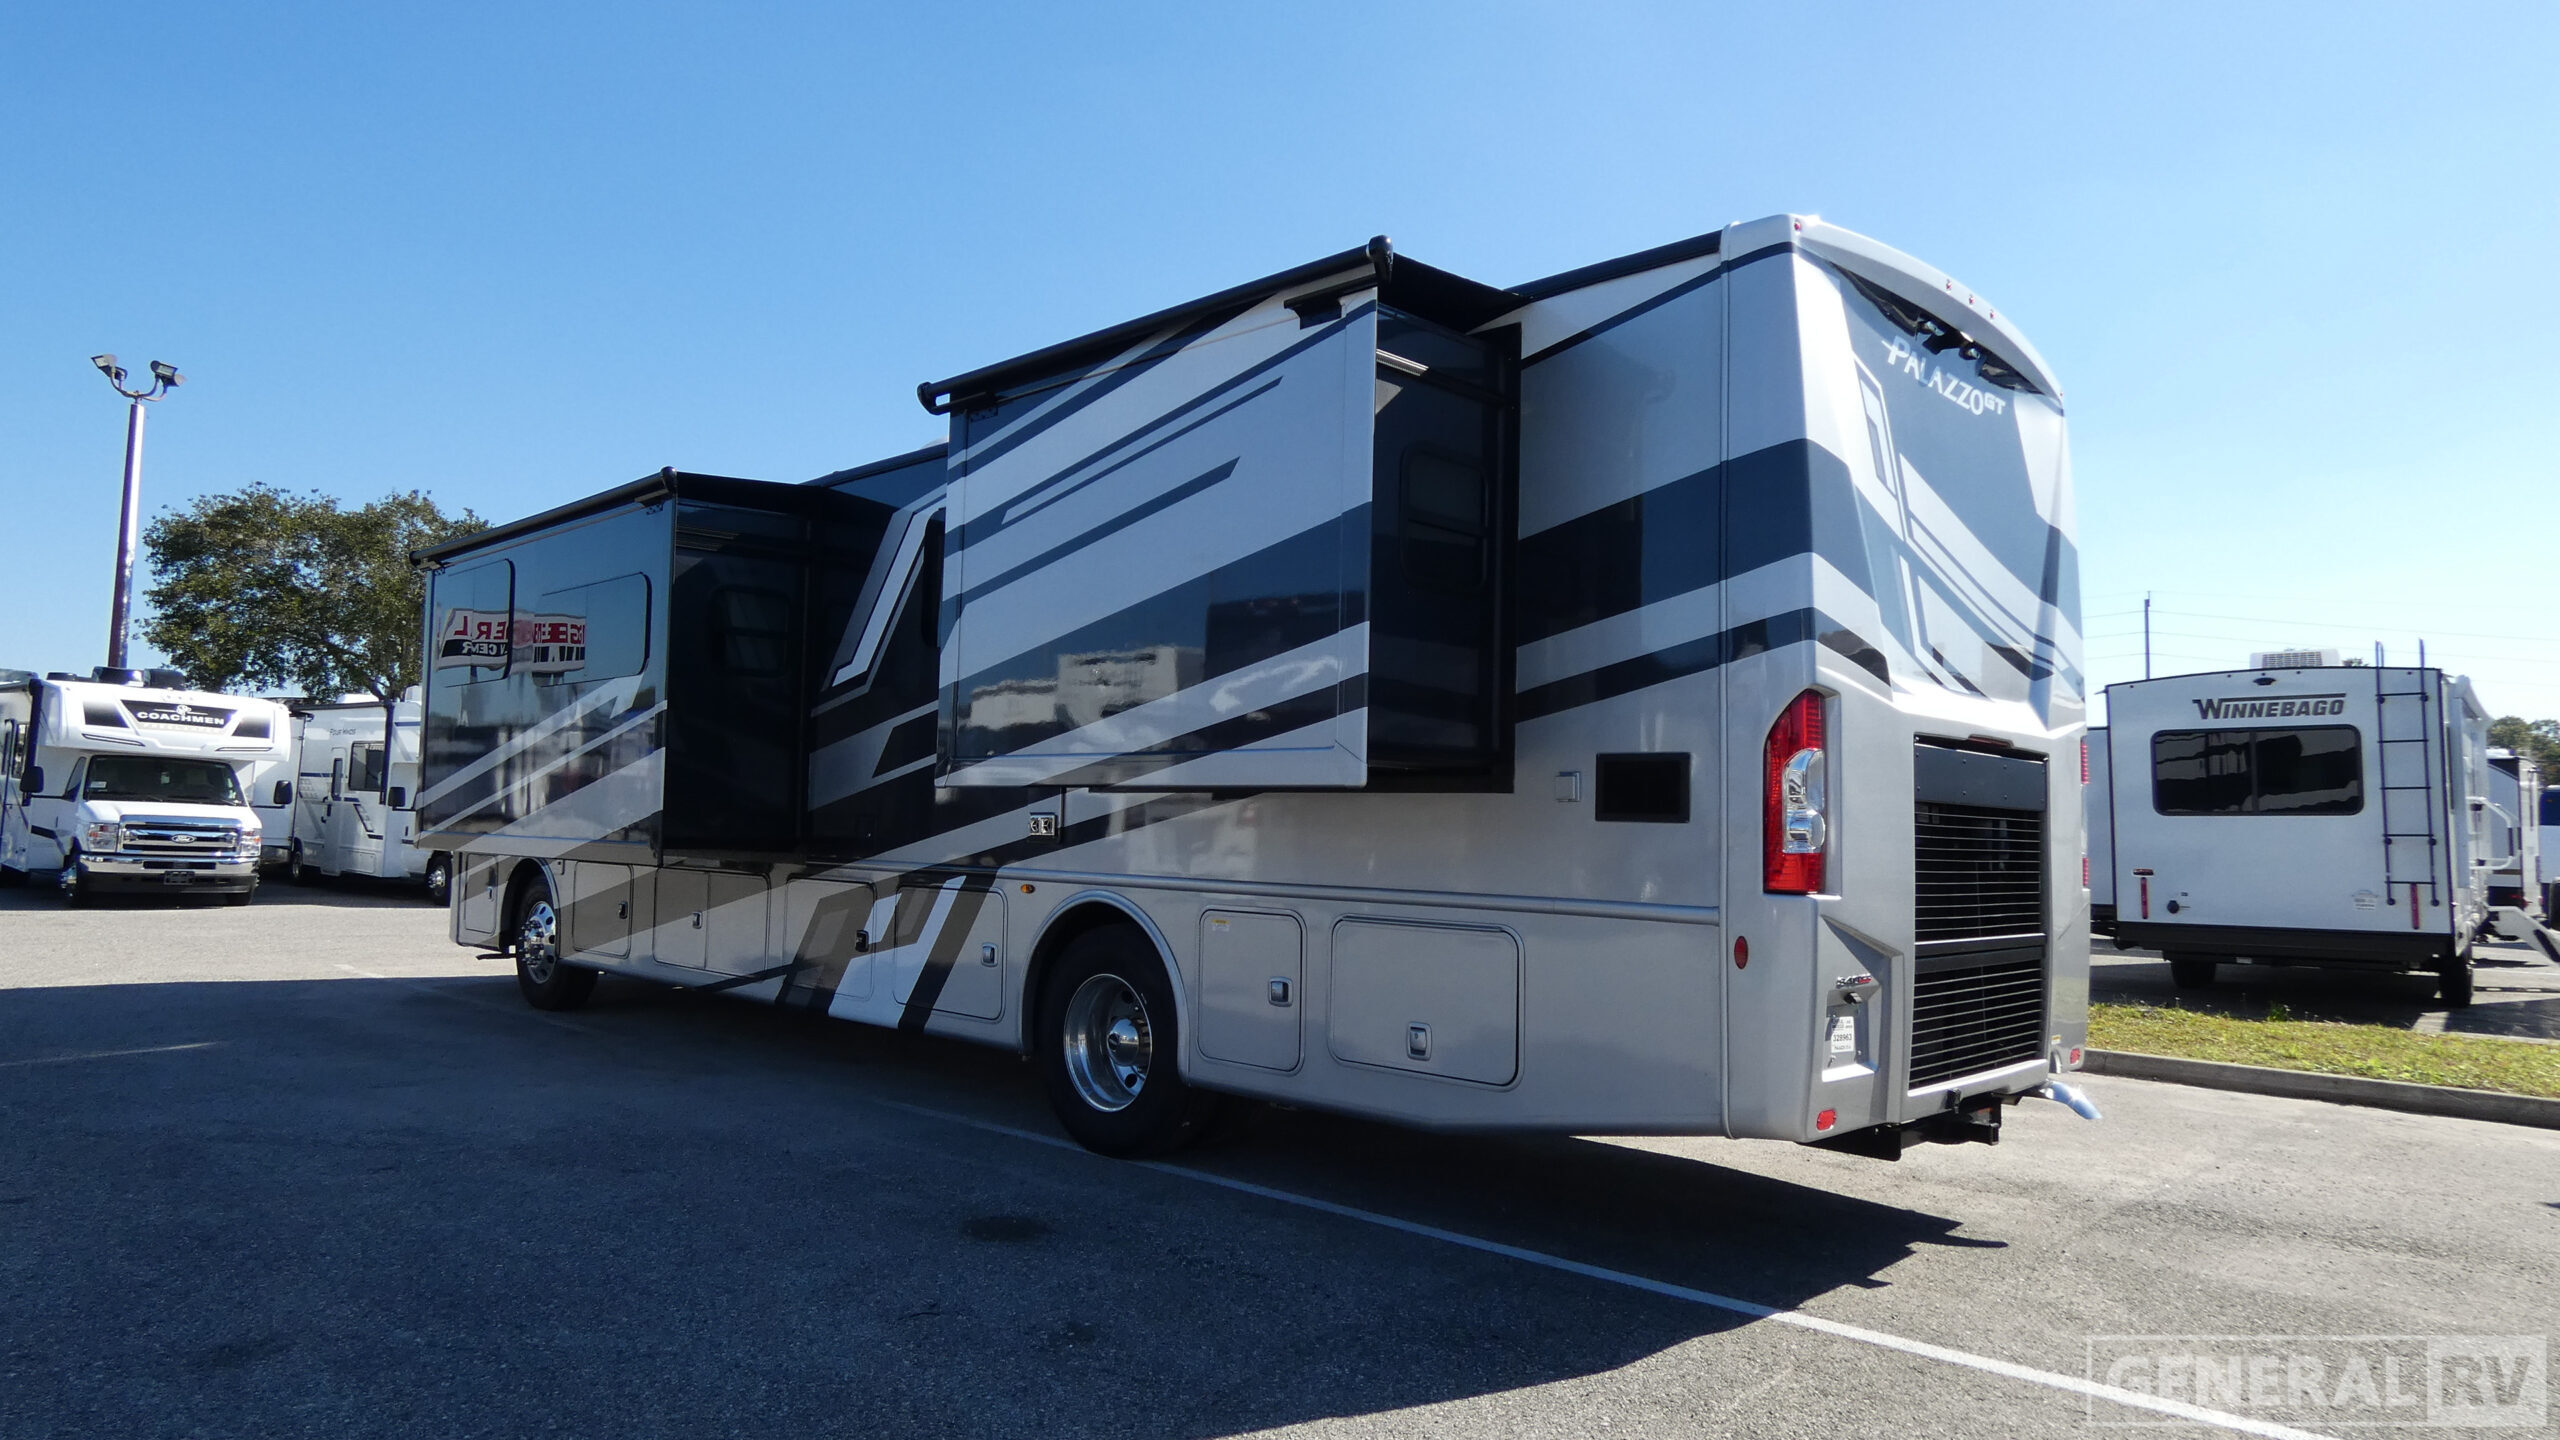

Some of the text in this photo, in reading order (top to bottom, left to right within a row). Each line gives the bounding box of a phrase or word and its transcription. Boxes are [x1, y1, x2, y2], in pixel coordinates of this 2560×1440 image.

[1881, 335, 2006, 416] PALAZZO GT
[136, 711, 225, 726] COACHMEN
[2192, 693, 2347, 720] WINNEBAGO
